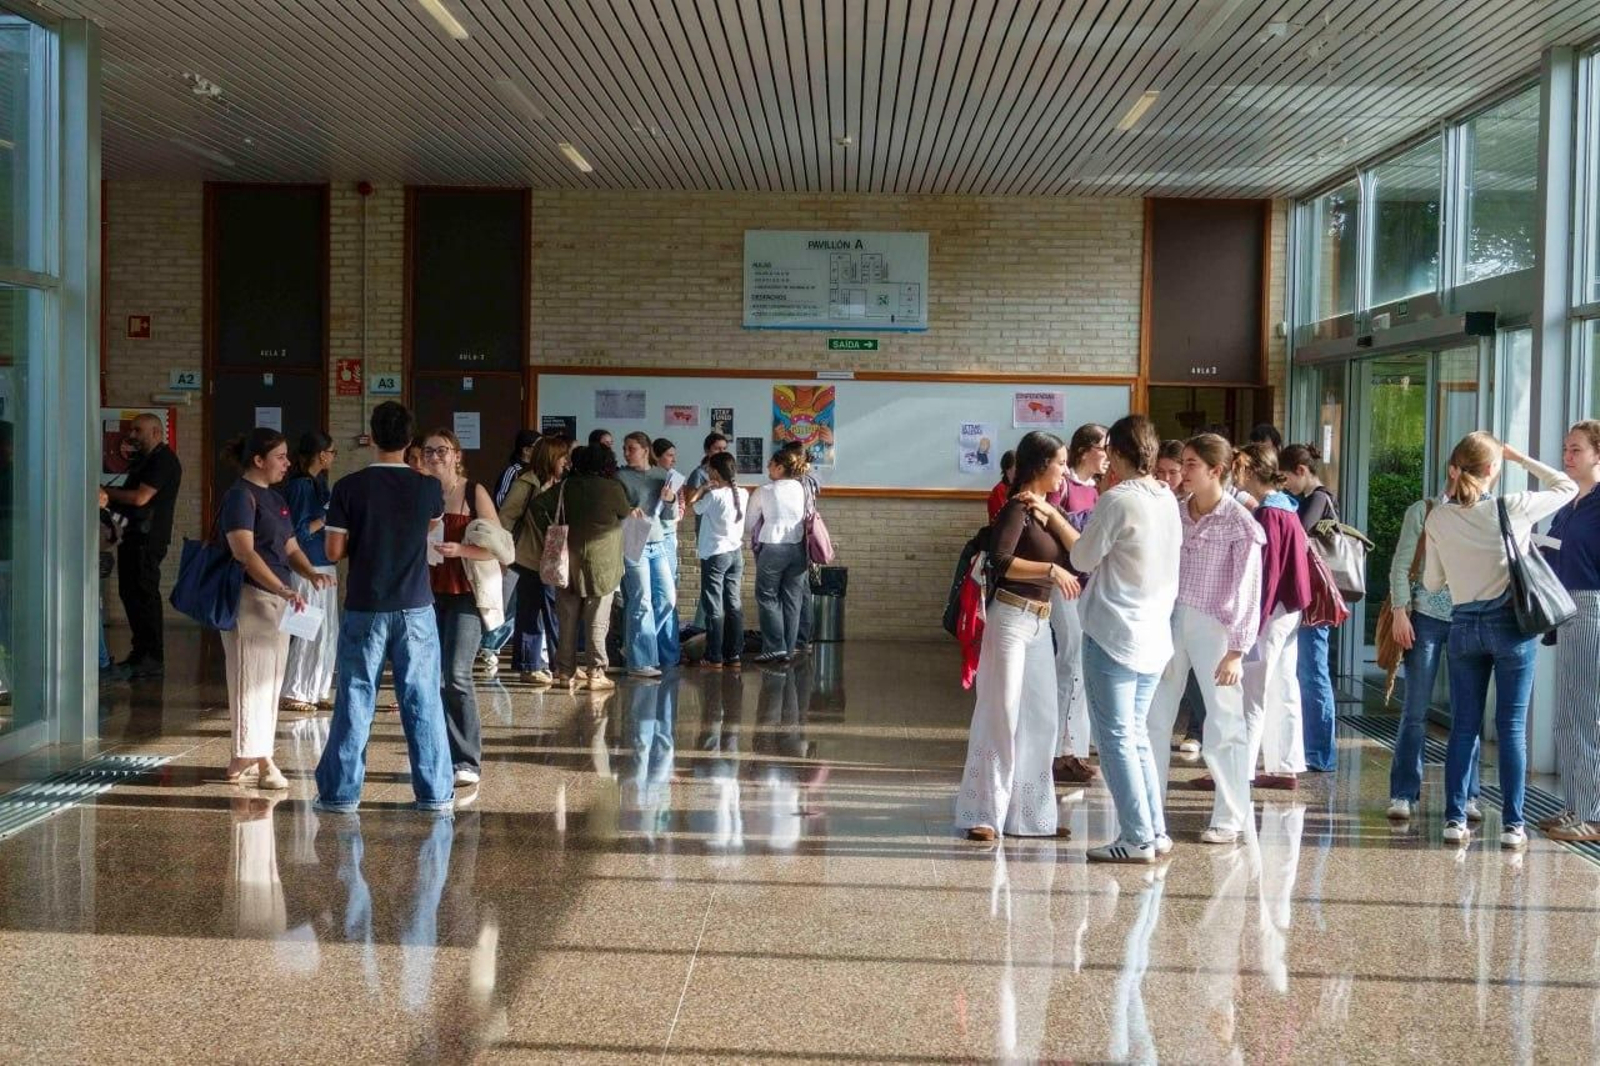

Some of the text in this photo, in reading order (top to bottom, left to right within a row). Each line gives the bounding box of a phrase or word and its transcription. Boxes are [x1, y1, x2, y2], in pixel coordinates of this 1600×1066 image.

[808, 239, 864, 250] PAVILLÓN A
[260, 349, 279, 357] AULA
[177, 374, 195, 385] A2
[377, 377, 395, 389] A3
